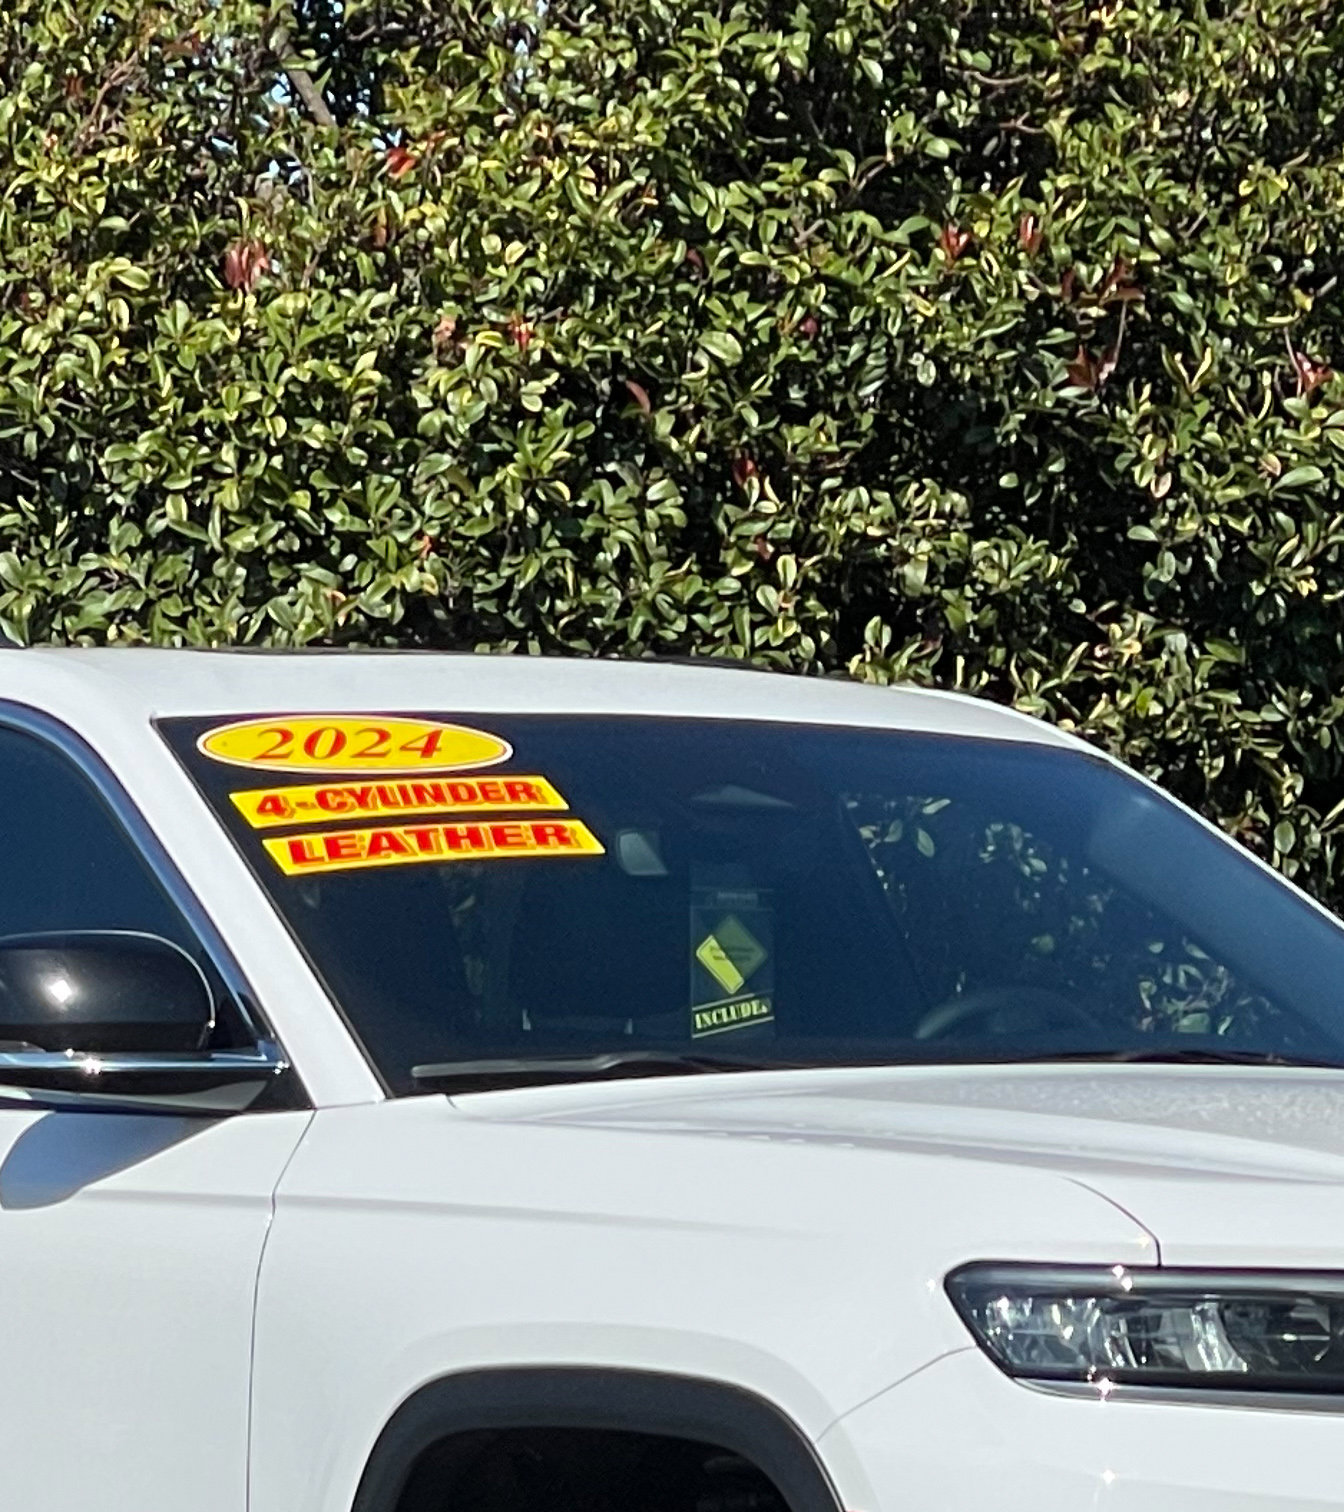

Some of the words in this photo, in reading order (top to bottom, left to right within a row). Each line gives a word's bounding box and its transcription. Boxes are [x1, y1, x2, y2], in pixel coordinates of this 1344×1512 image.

[255, 726, 444, 761] 2024
[255, 780, 546, 820] 4-CYLINDER
[287, 823, 576, 866] LEATHER
